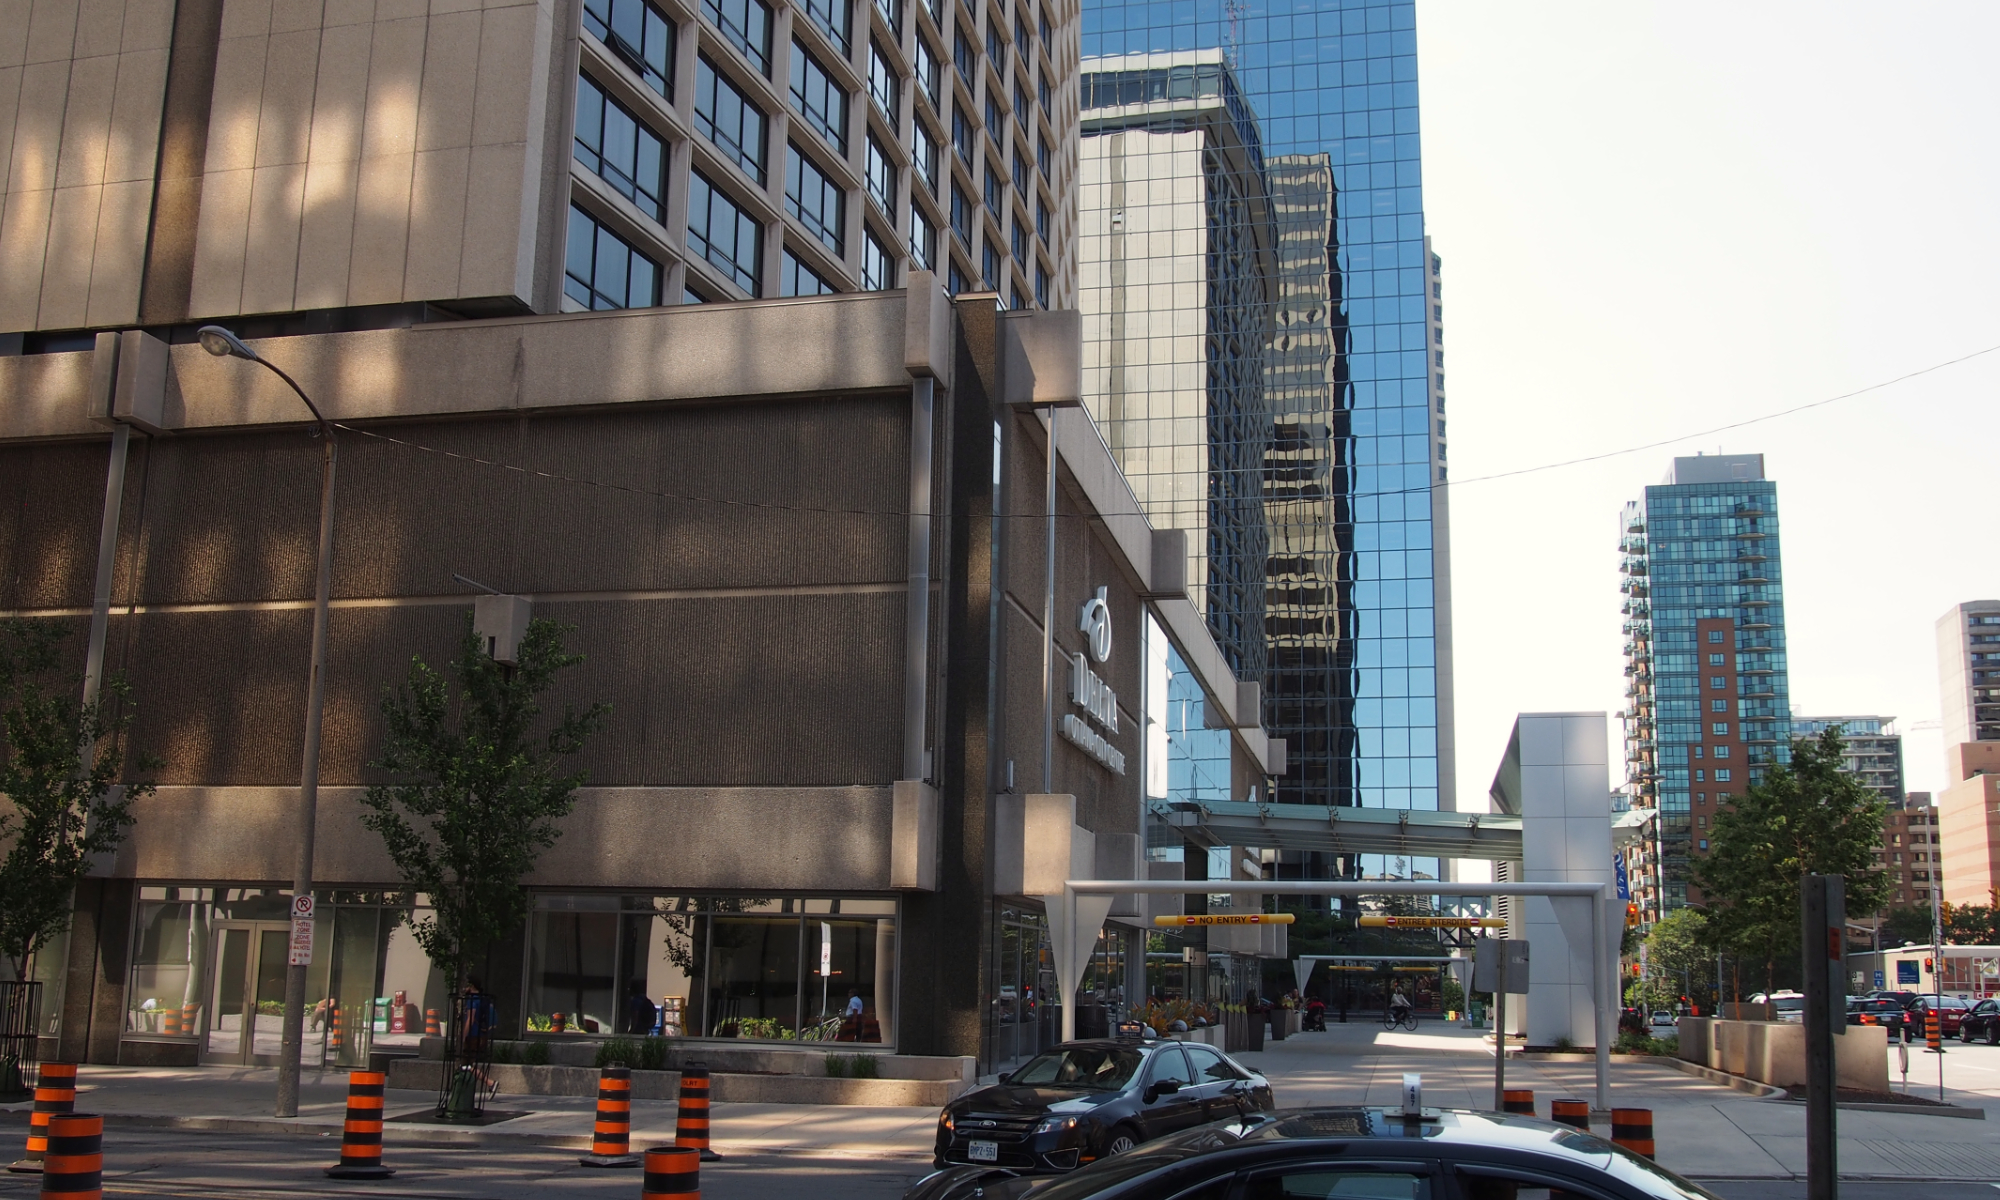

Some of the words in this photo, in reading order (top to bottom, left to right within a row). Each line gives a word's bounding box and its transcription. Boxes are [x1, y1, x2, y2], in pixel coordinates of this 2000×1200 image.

[1073, 651, 1119, 735] DELTA
[1199, 916, 1213, 924] NO
[1217, 916, 1247, 924] ENTRY
[1430, 918, 1468, 926] INTERDITE
